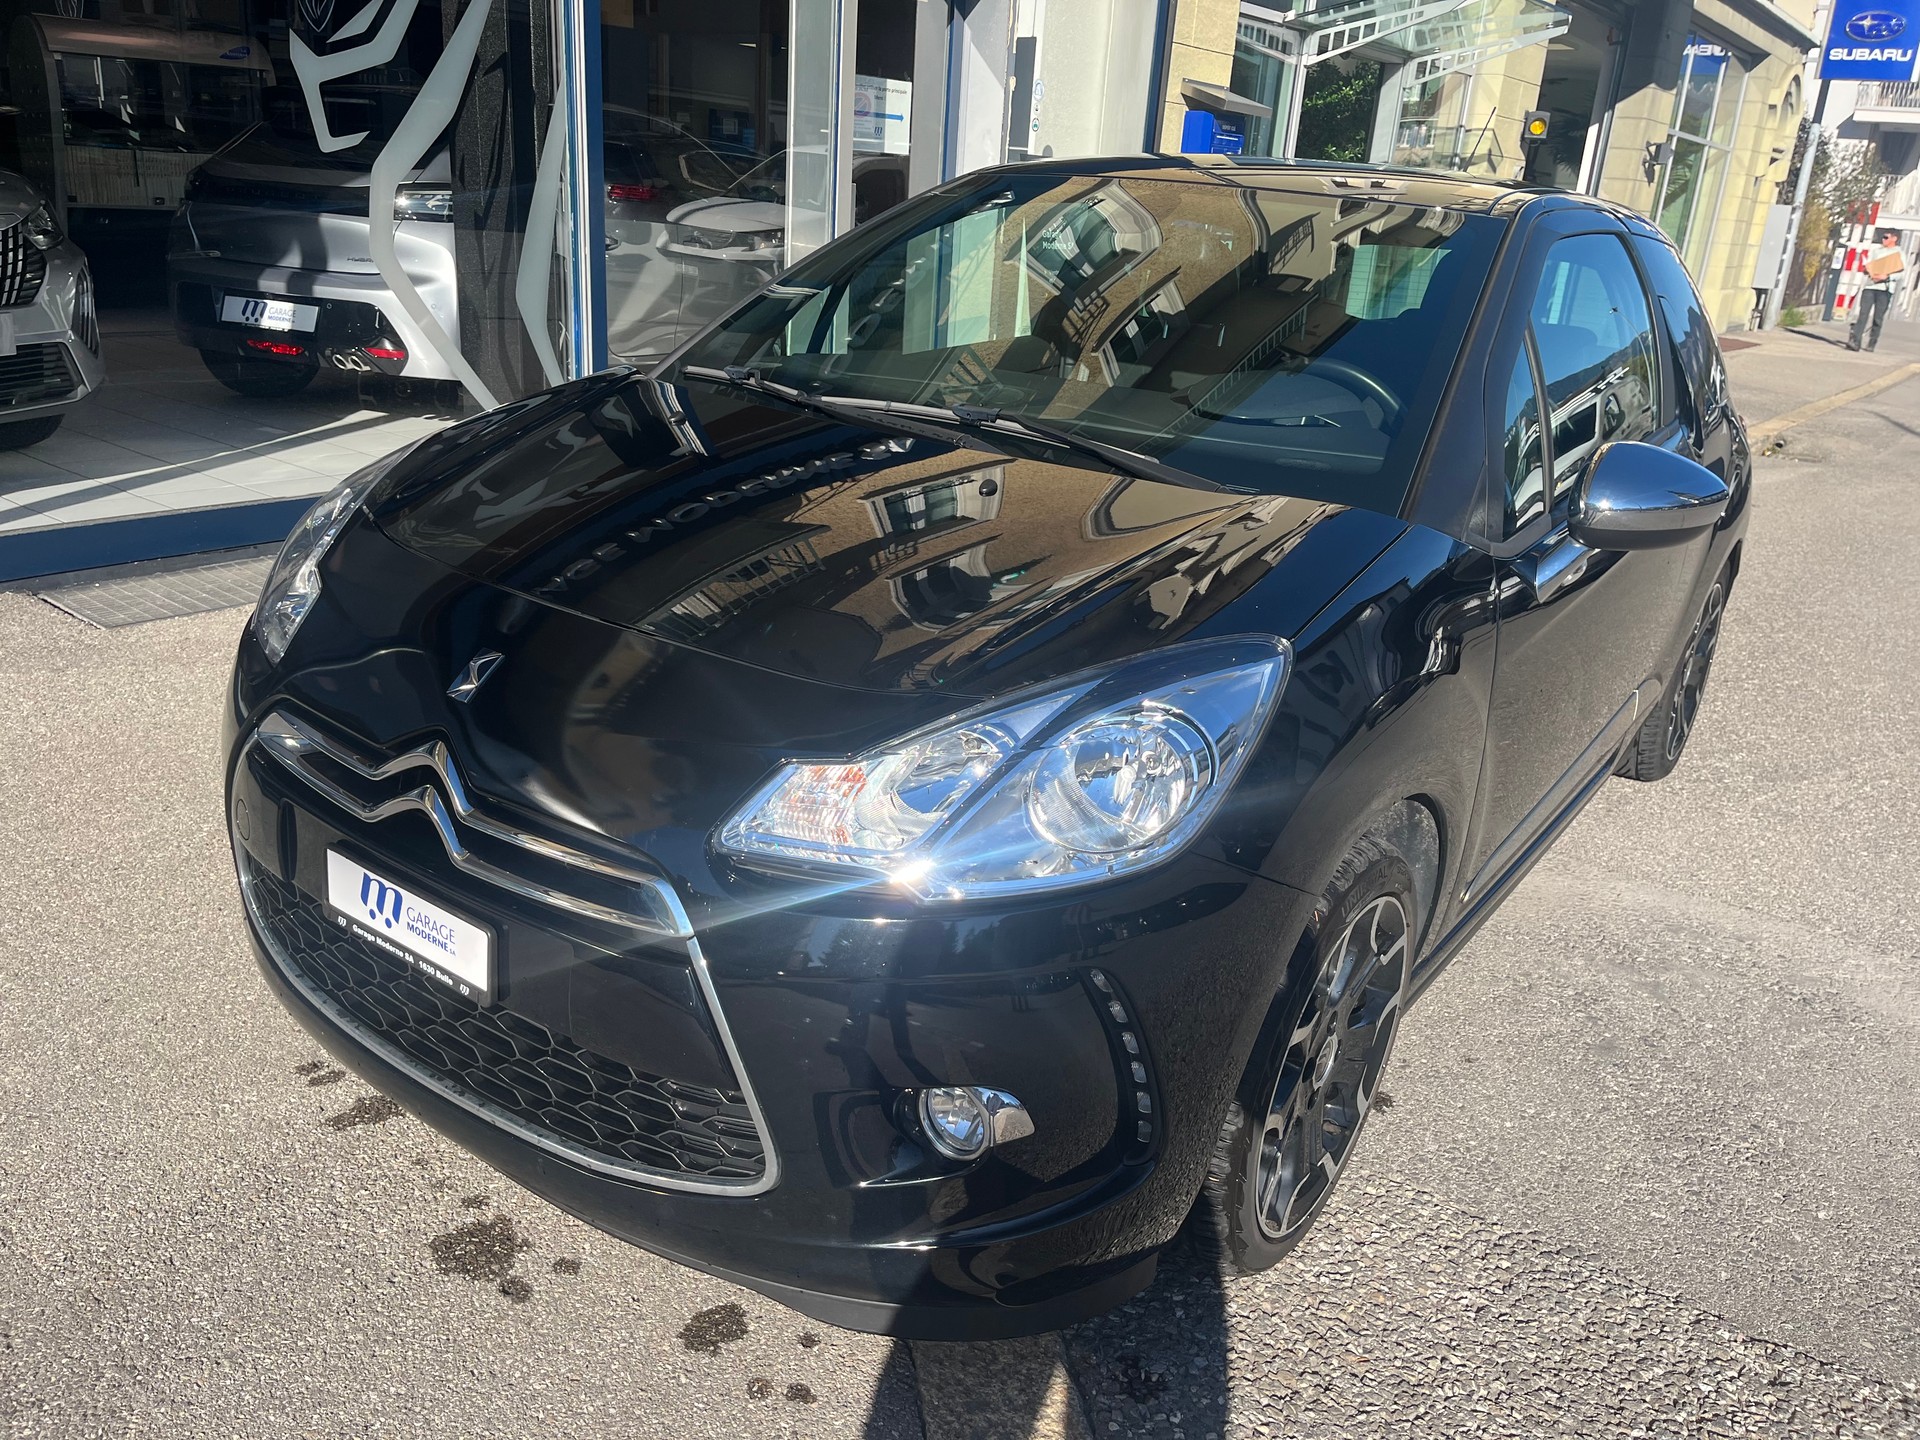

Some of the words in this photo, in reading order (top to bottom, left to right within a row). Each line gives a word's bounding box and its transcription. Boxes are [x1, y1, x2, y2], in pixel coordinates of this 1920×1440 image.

[1828, 47, 1913, 62] SUBARU
[267, 315, 292, 323] MODERNE
[268, 306, 297, 319] GARAGE
[406, 906, 456, 944] GARAGE
[406, 922, 449, 952] MODERNE
[352, 923, 375, 942] Garage
[376, 936, 404, 958] Moderne
[404, 953, 415, 964] SA
[418, 960, 435, 975] 1630
[435, 969, 453, 985] Bulle
